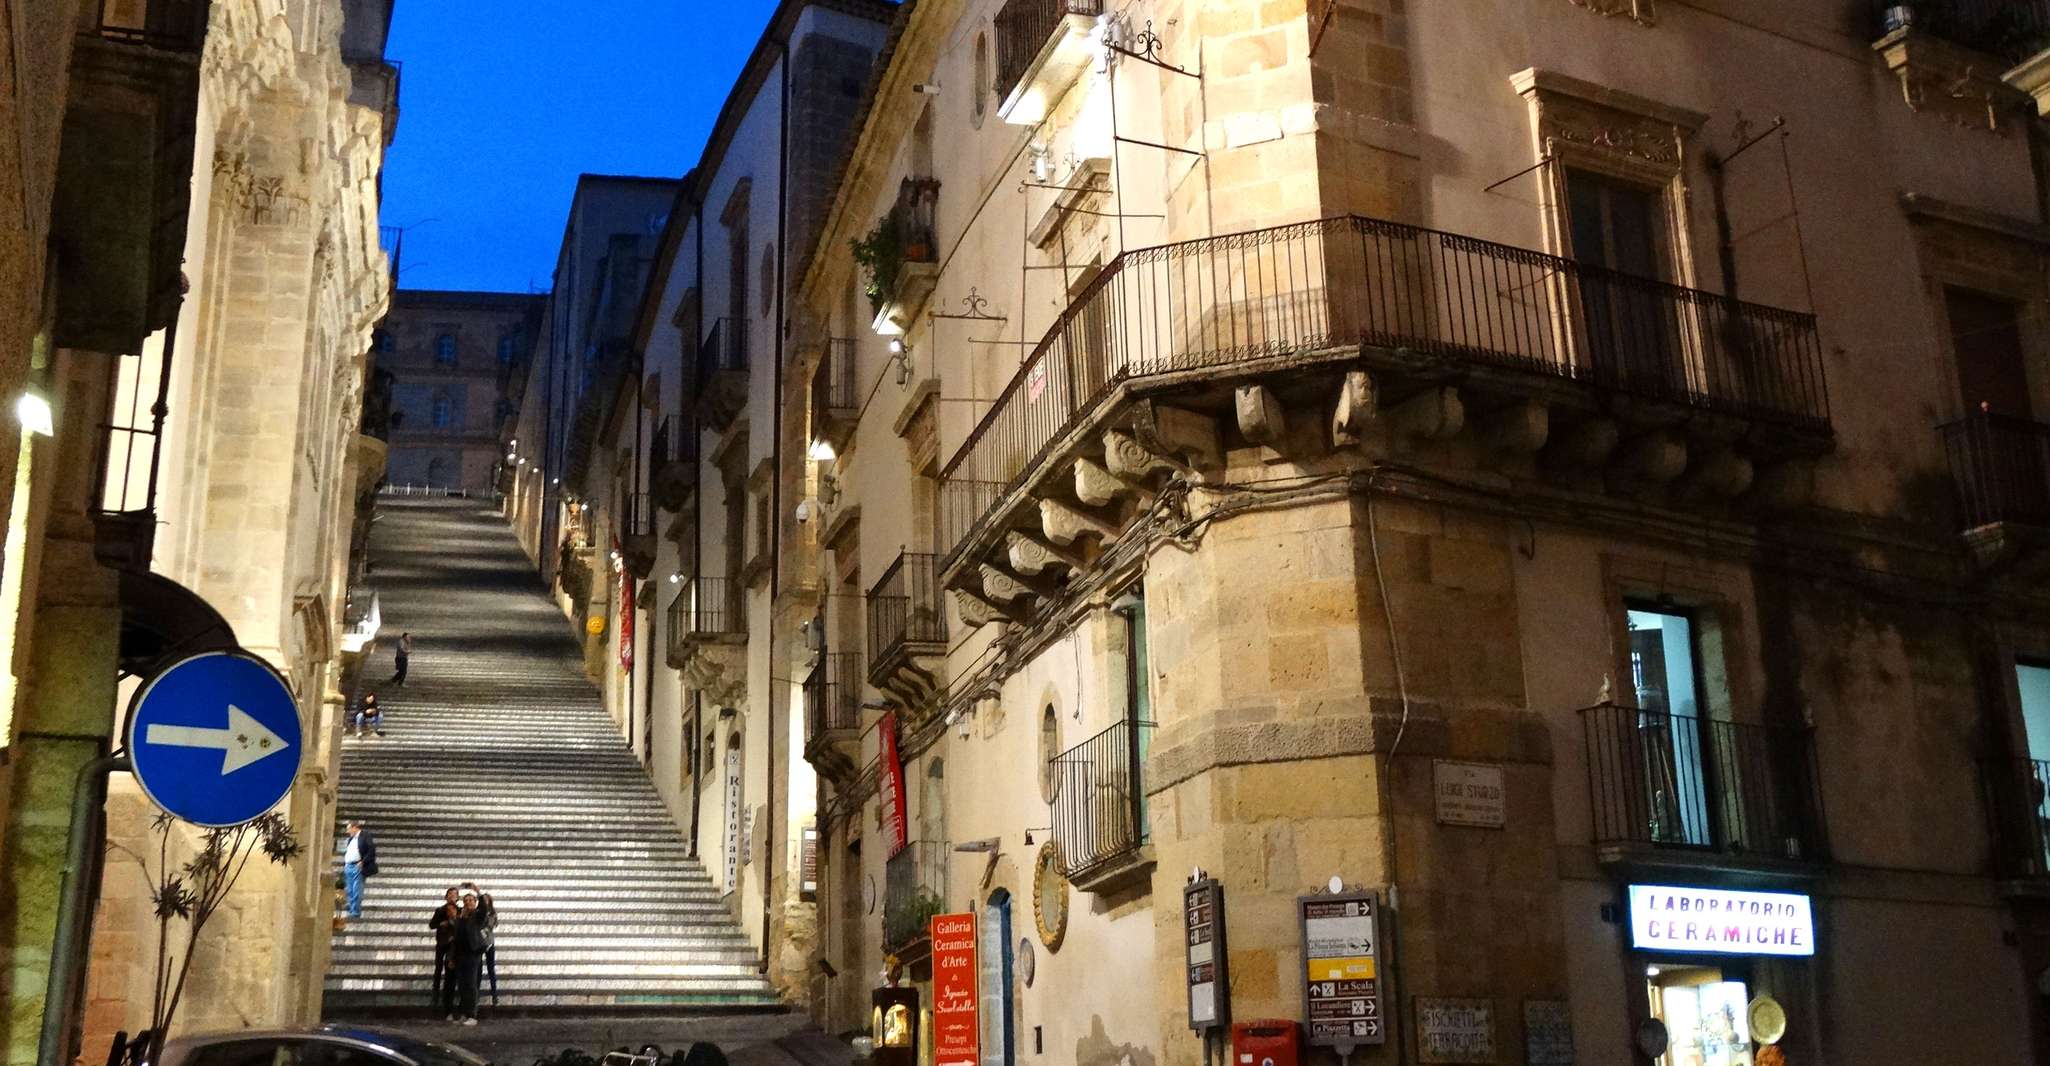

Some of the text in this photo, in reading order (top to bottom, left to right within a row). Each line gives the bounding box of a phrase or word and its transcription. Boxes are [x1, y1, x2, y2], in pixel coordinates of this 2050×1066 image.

[729, 775, 740, 888] Ristorante
[1650, 895, 1795, 918] LABORATORIO
[937, 921, 971, 934] Galleria
[1648, 920, 1802, 946] CERAMICHE
[935, 938, 974, 951] Ceramica
[942, 956, 967, 968] d'Arte
[1338, 981, 1373, 990] La Scala
